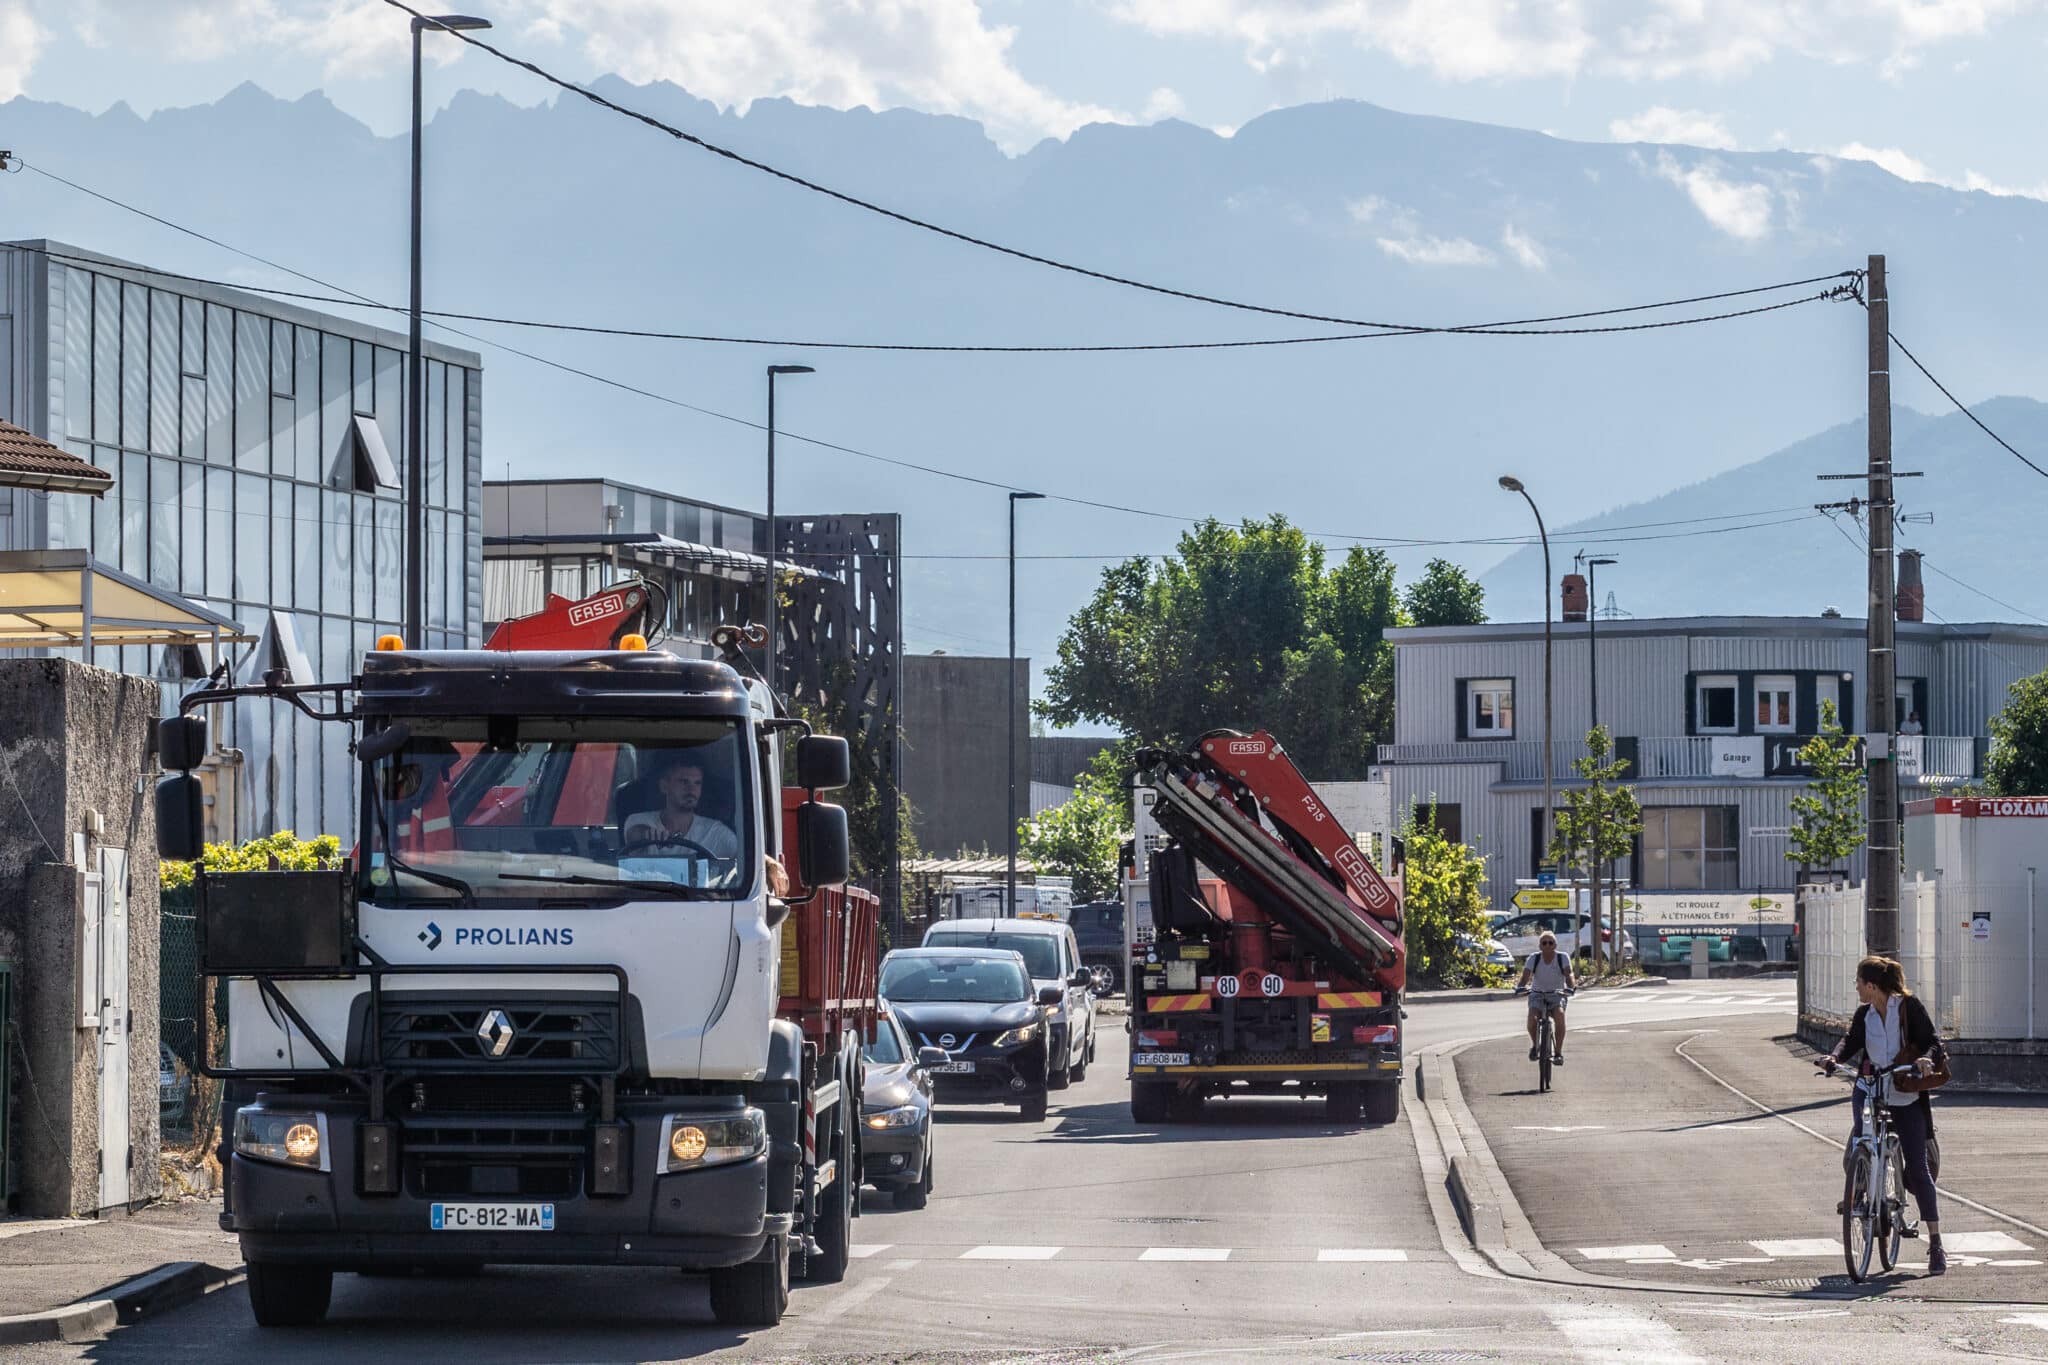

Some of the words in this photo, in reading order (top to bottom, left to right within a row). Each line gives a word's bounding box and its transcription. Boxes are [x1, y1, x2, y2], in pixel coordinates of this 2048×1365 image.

[573, 599, 619, 622] FASSI
[1232, 743, 1264, 752] FASSI
[1723, 753, 1752, 763] Garage
[1302, 795, 1326, 822] F215
[1993, 802, 2048, 816] LOXAM
[1338, 850, 1385, 904] FASSI
[1676, 901, 1687, 909] ICI
[1689, 901, 1720, 909] ROULEZ
[455, 928, 574, 946] PROLIANS
[1658, 927, 1689, 936] CENTRE
[1220, 977, 1236, 995] 80
[1264, 976, 1281, 994] 90
[444, 1208, 540, 1226] FC-812-MA
